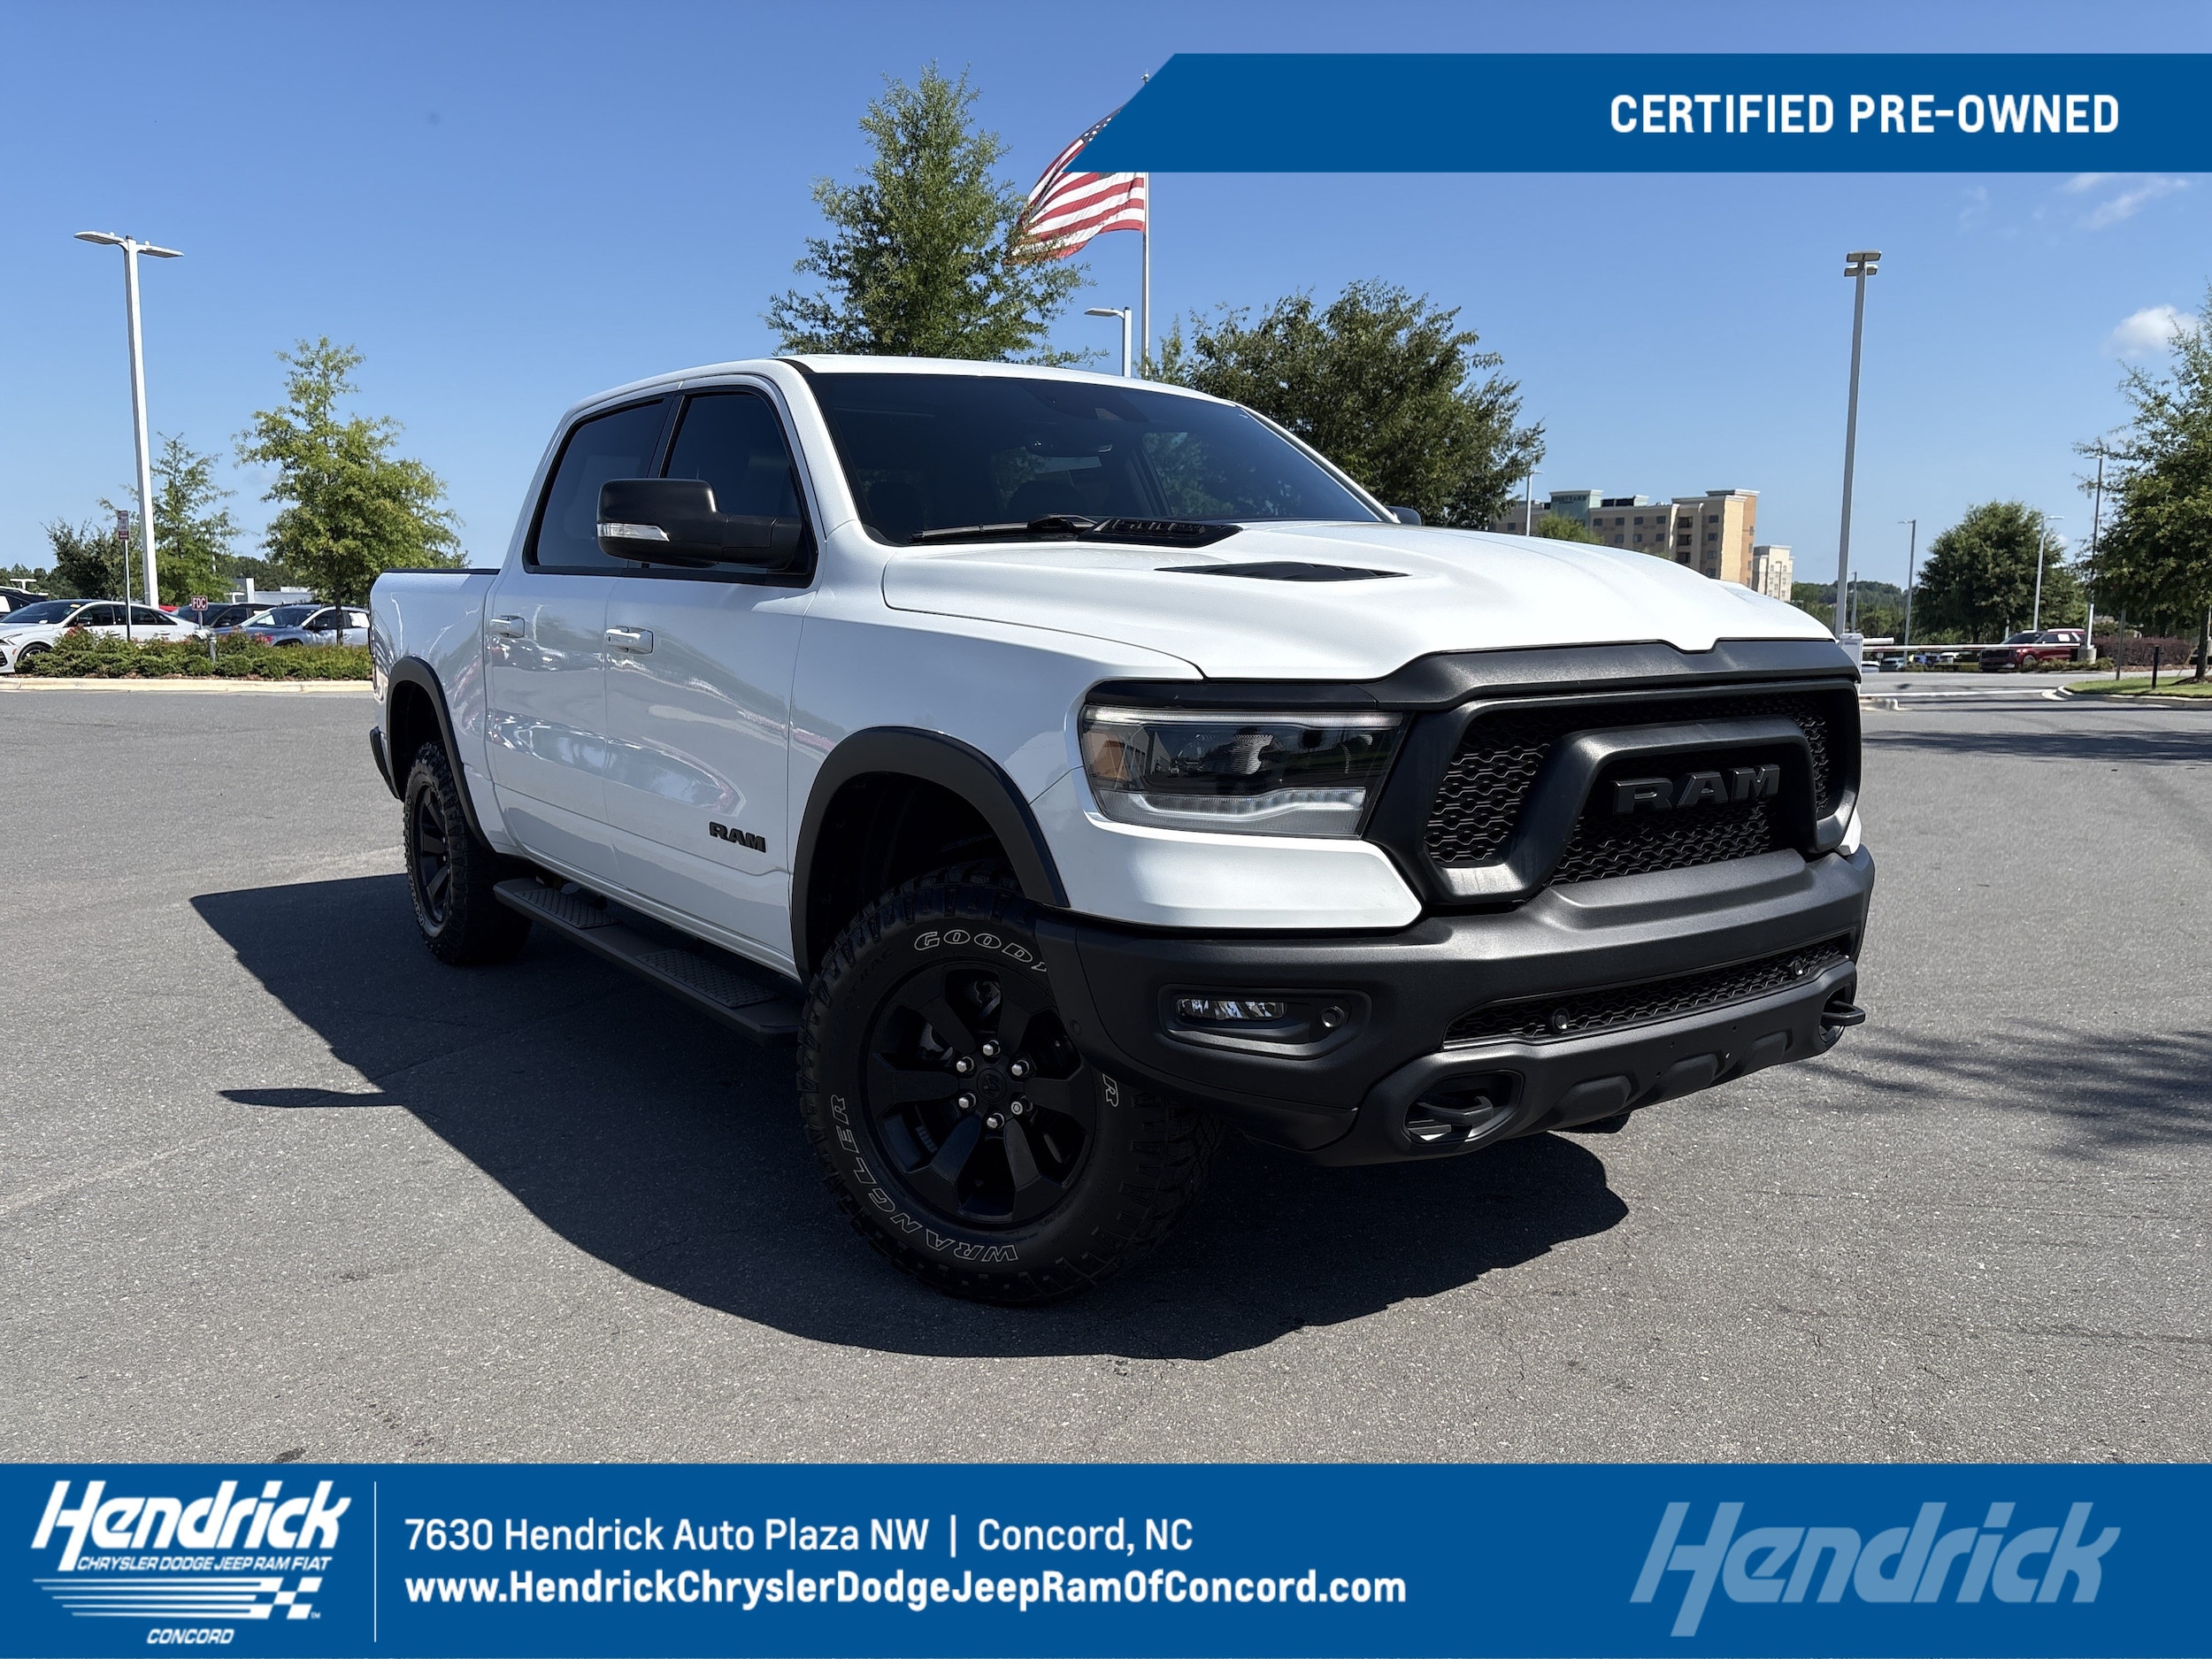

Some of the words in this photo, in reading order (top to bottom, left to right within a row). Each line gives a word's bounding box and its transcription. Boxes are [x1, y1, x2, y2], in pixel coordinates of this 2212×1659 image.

[192, 597, 206, 609] FDC
[1612, 764, 1780, 814] RAM
[709, 821, 766, 854] RAM
[830, 1094, 1019, 1263] WRANGLER
